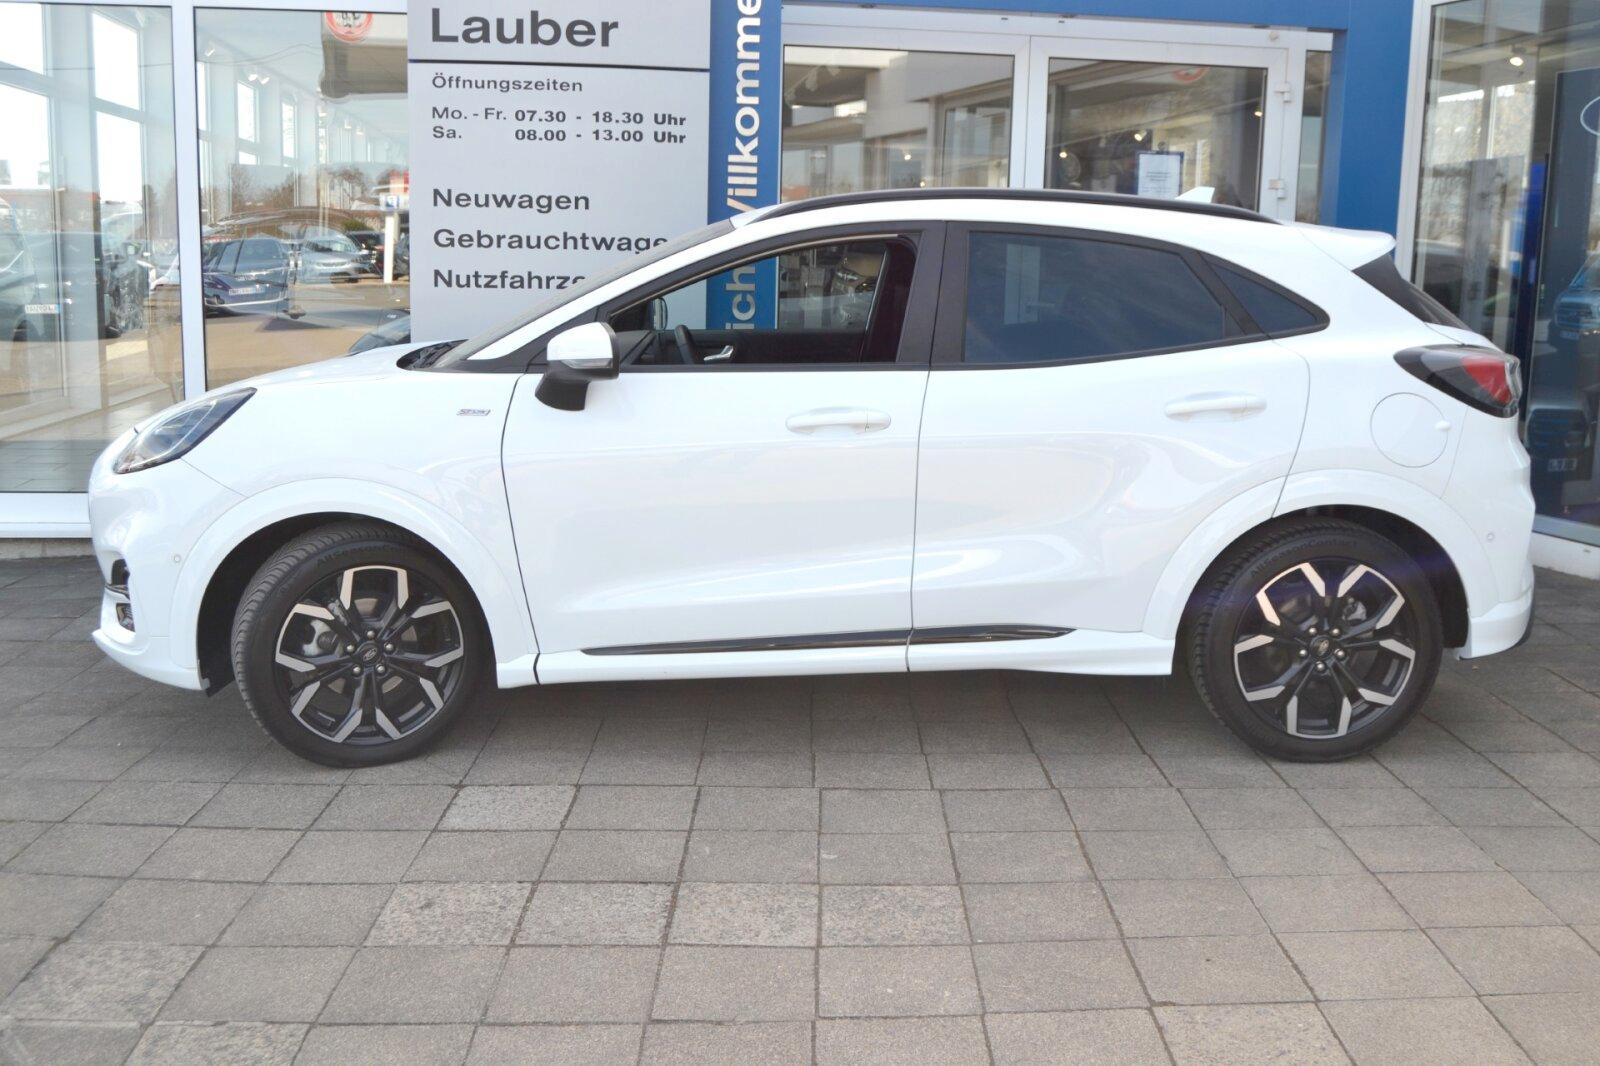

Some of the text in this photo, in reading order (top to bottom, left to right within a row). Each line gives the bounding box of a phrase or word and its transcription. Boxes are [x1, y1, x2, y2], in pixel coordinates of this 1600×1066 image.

[431, 7, 619, 48] Lauber
[432, 72, 583, 93] Öffnungszeiten
[432, 106, 468, 120] Mo.
[484, 107, 507, 120] Fr.
[514, 109, 567, 123] 07.30
[592, 110, 644, 125] 18.30
[653, 112, 687, 126] Uhr
[432, 125, 462, 139] Sa.
[514, 129, 567, 142] 08.00
[592, 129, 644, 143] 13.00
[653, 130, 687, 144] Uhr
[432, 188, 590, 214] Neuwagen
